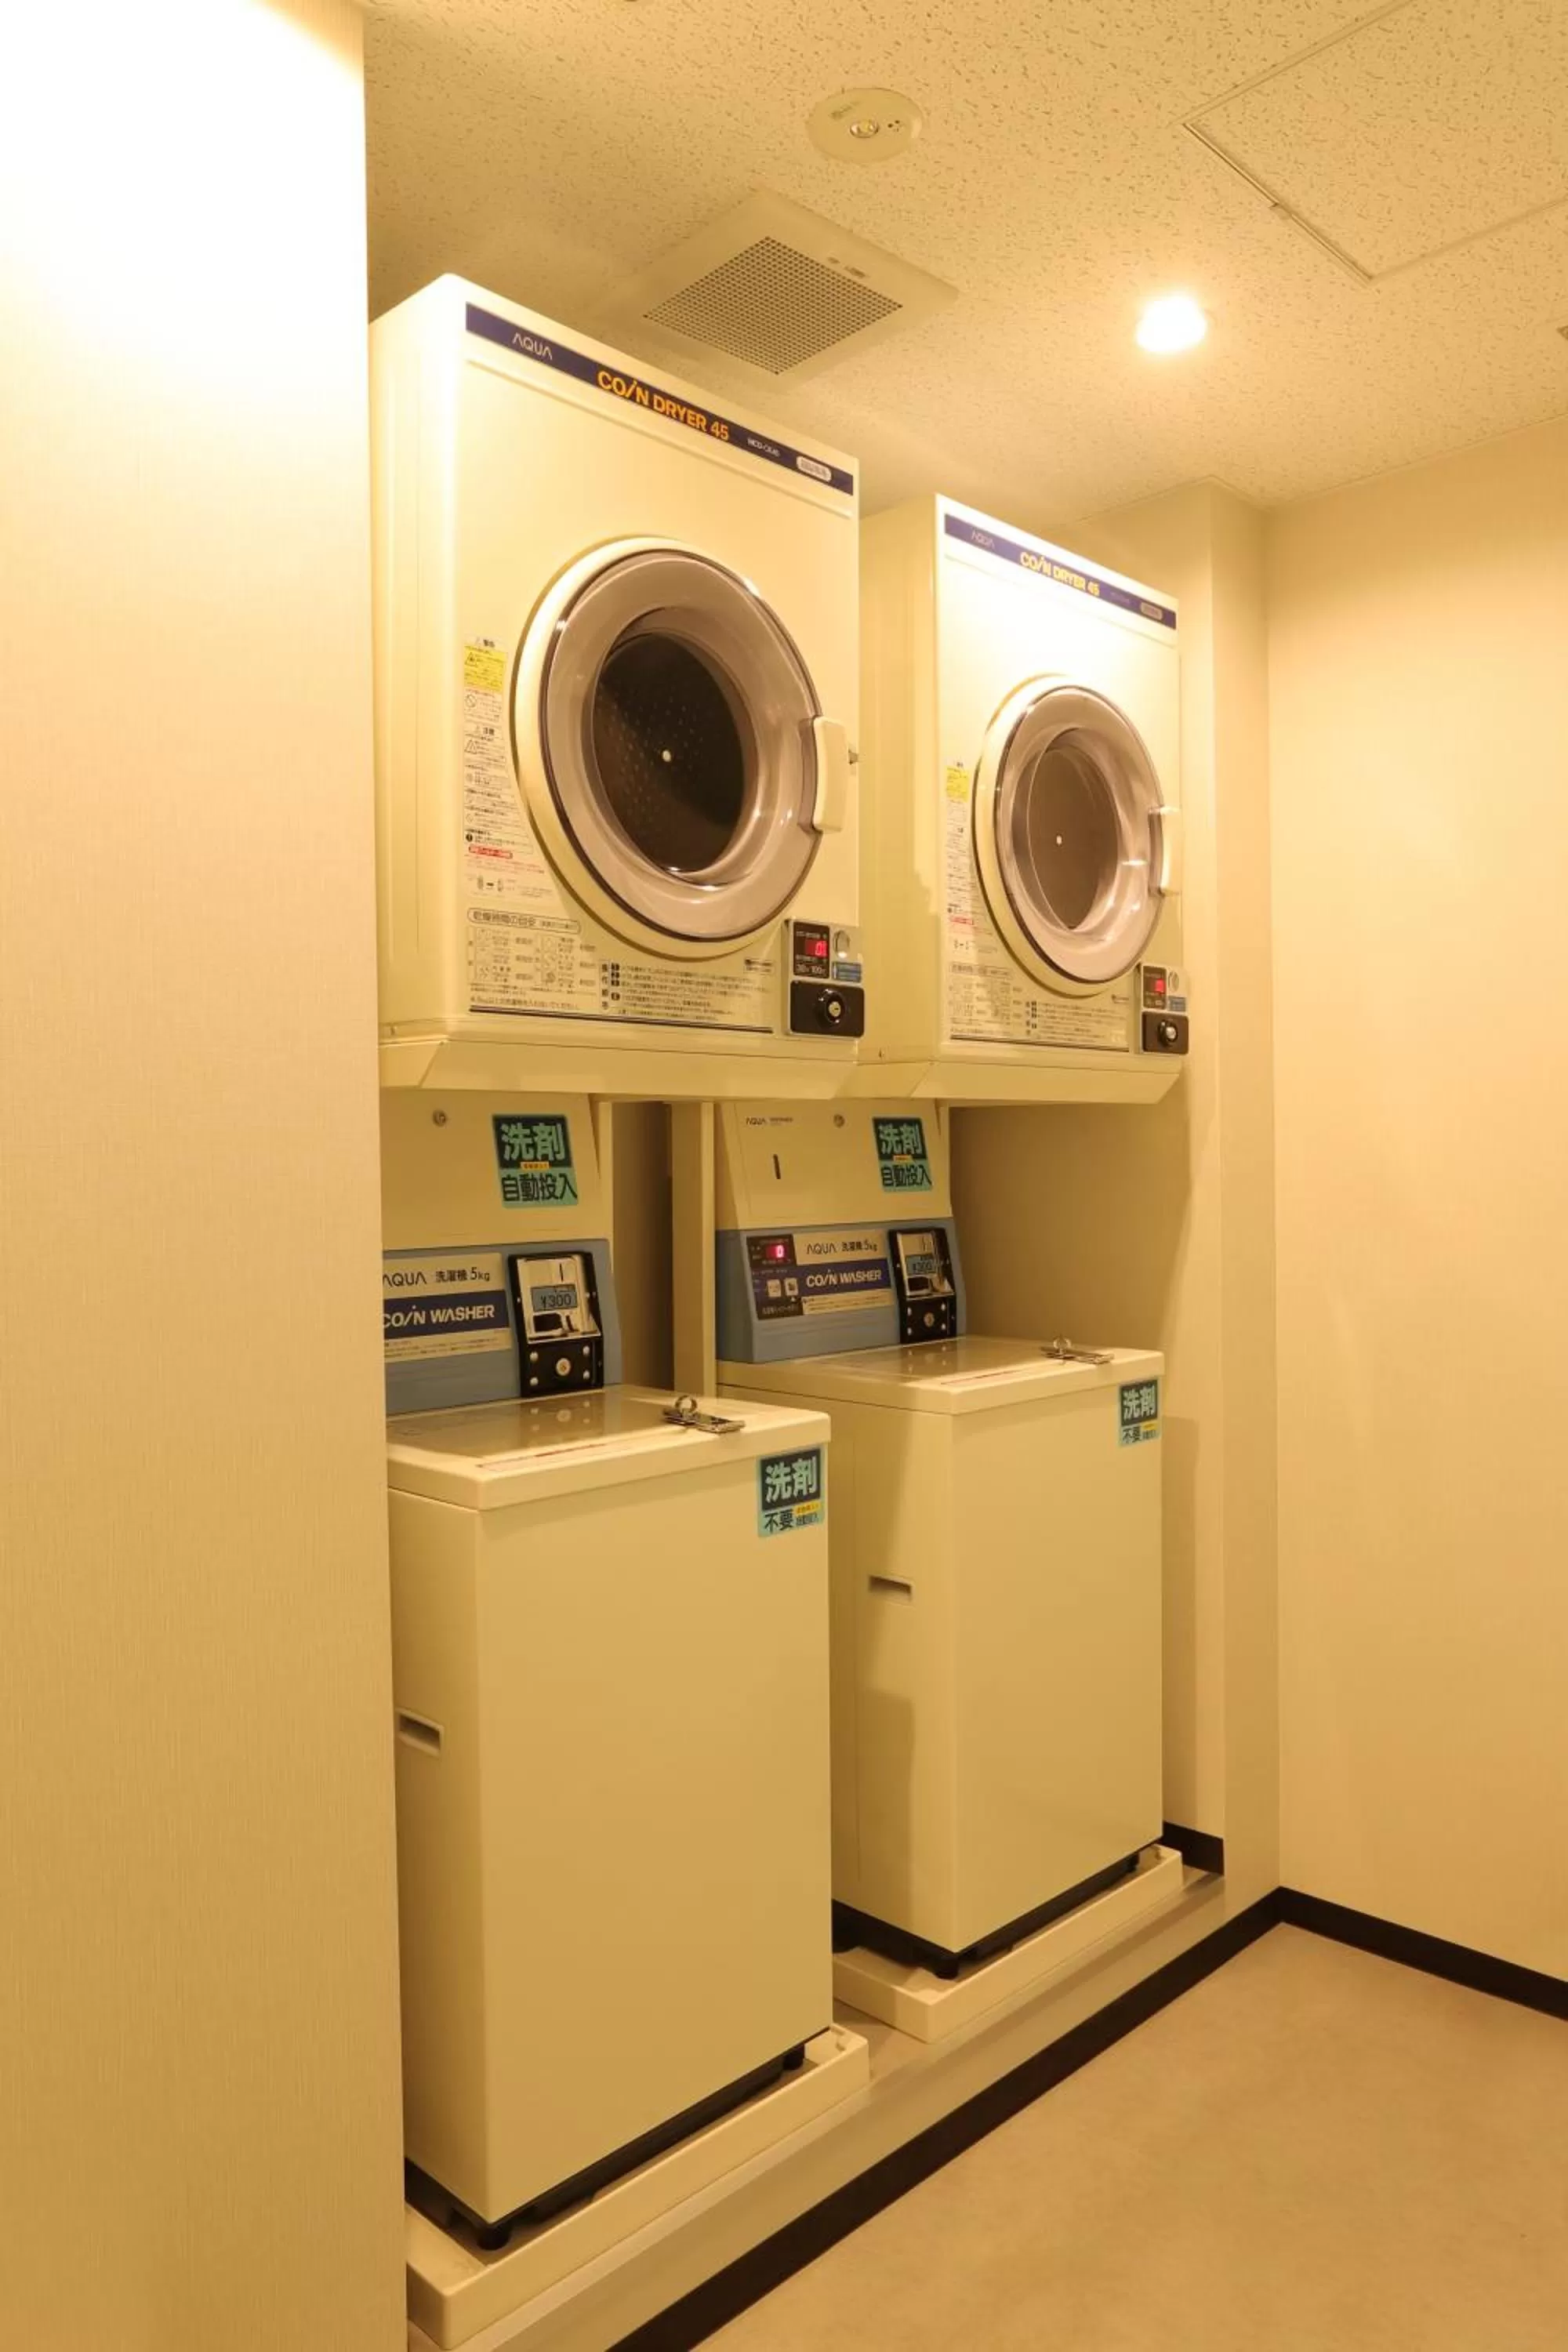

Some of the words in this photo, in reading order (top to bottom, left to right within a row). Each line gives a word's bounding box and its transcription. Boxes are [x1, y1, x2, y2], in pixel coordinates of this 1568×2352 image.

[512, 332, 553, 361] AQUA
[653, 394, 707, 432] DRYER
[710, 421, 730, 441] 45
[1053, 565, 1086, 590] DRYER
[1087, 581, 1101, 596] 45
[501, 1123, 565, 1161] 洗剤
[879, 1123, 923, 1155] 洗剤
[502, 1173, 578, 1202] 自動投入
[881, 1163, 932, 1187] 自動投入
[807, 1243, 838, 1255] AQUA
[383, 1271, 427, 1287] AQUA
[840, 1269, 883, 1284] WASHER
[430, 1304, 495, 1324] WASHER
[1122, 1385, 1156, 1421] 洗剤
[765, 1455, 818, 1503] 洗剤
[764, 1508, 793, 1533] 不要
